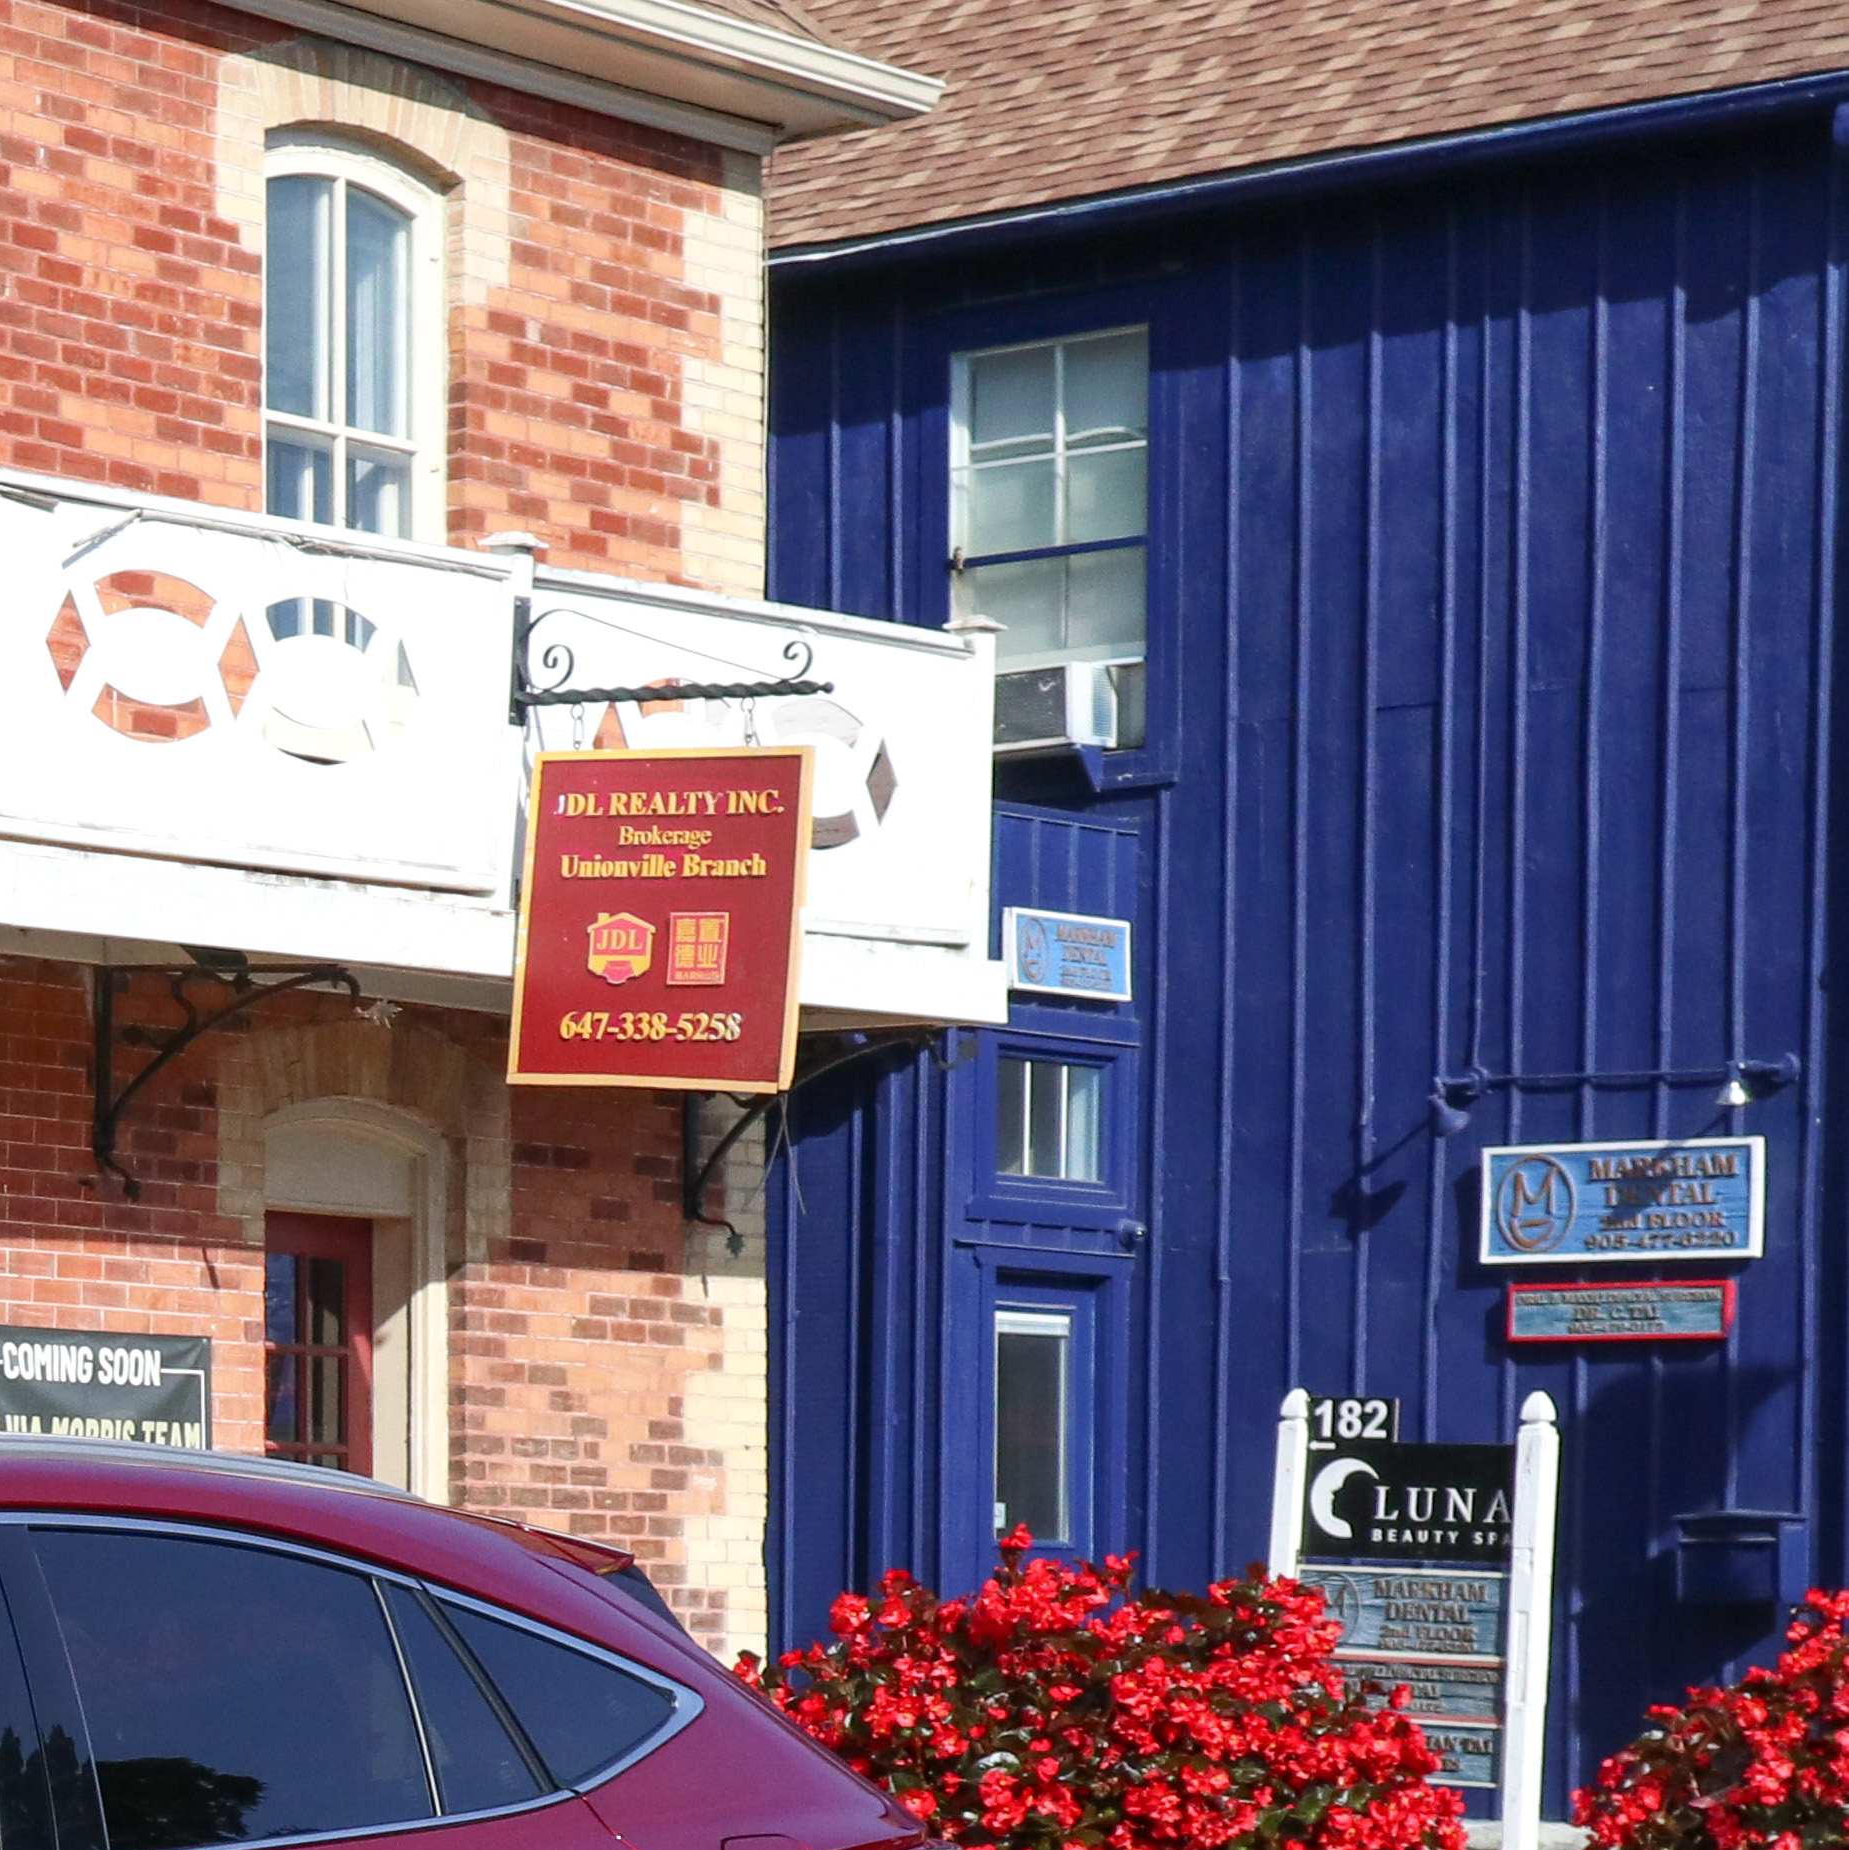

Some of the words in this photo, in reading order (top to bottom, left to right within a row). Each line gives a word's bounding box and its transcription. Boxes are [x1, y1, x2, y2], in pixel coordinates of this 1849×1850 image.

[554, 793, 603, 817] JDL
[609, 791, 723, 816] REALTY
[726, 789, 785, 814] INC.
[618, 825, 712, 849] Brokerage
[560, 854, 675, 878] Unionville
[682, 853, 766, 877] Branch
[596, 930, 643, 951] JDL
[559, 1011, 742, 1042] 647-338-5258
[1589, 1153, 1739, 1181] MARKHAM
[1606, 1182, 1718, 1207] DENTAL
[3, 1342, 94, 1384] COMING
[98, 1347, 161, 1387] SOON
[1313, 1399, 1388, 1440] 182
[1373, 1485, 1512, 1524] LUNA
[1371, 1528, 1459, 1545] BEAUTY
[1375, 1580, 1488, 1602] MARKHAM
[1385, 1601, 1471, 1623] DENTAL
